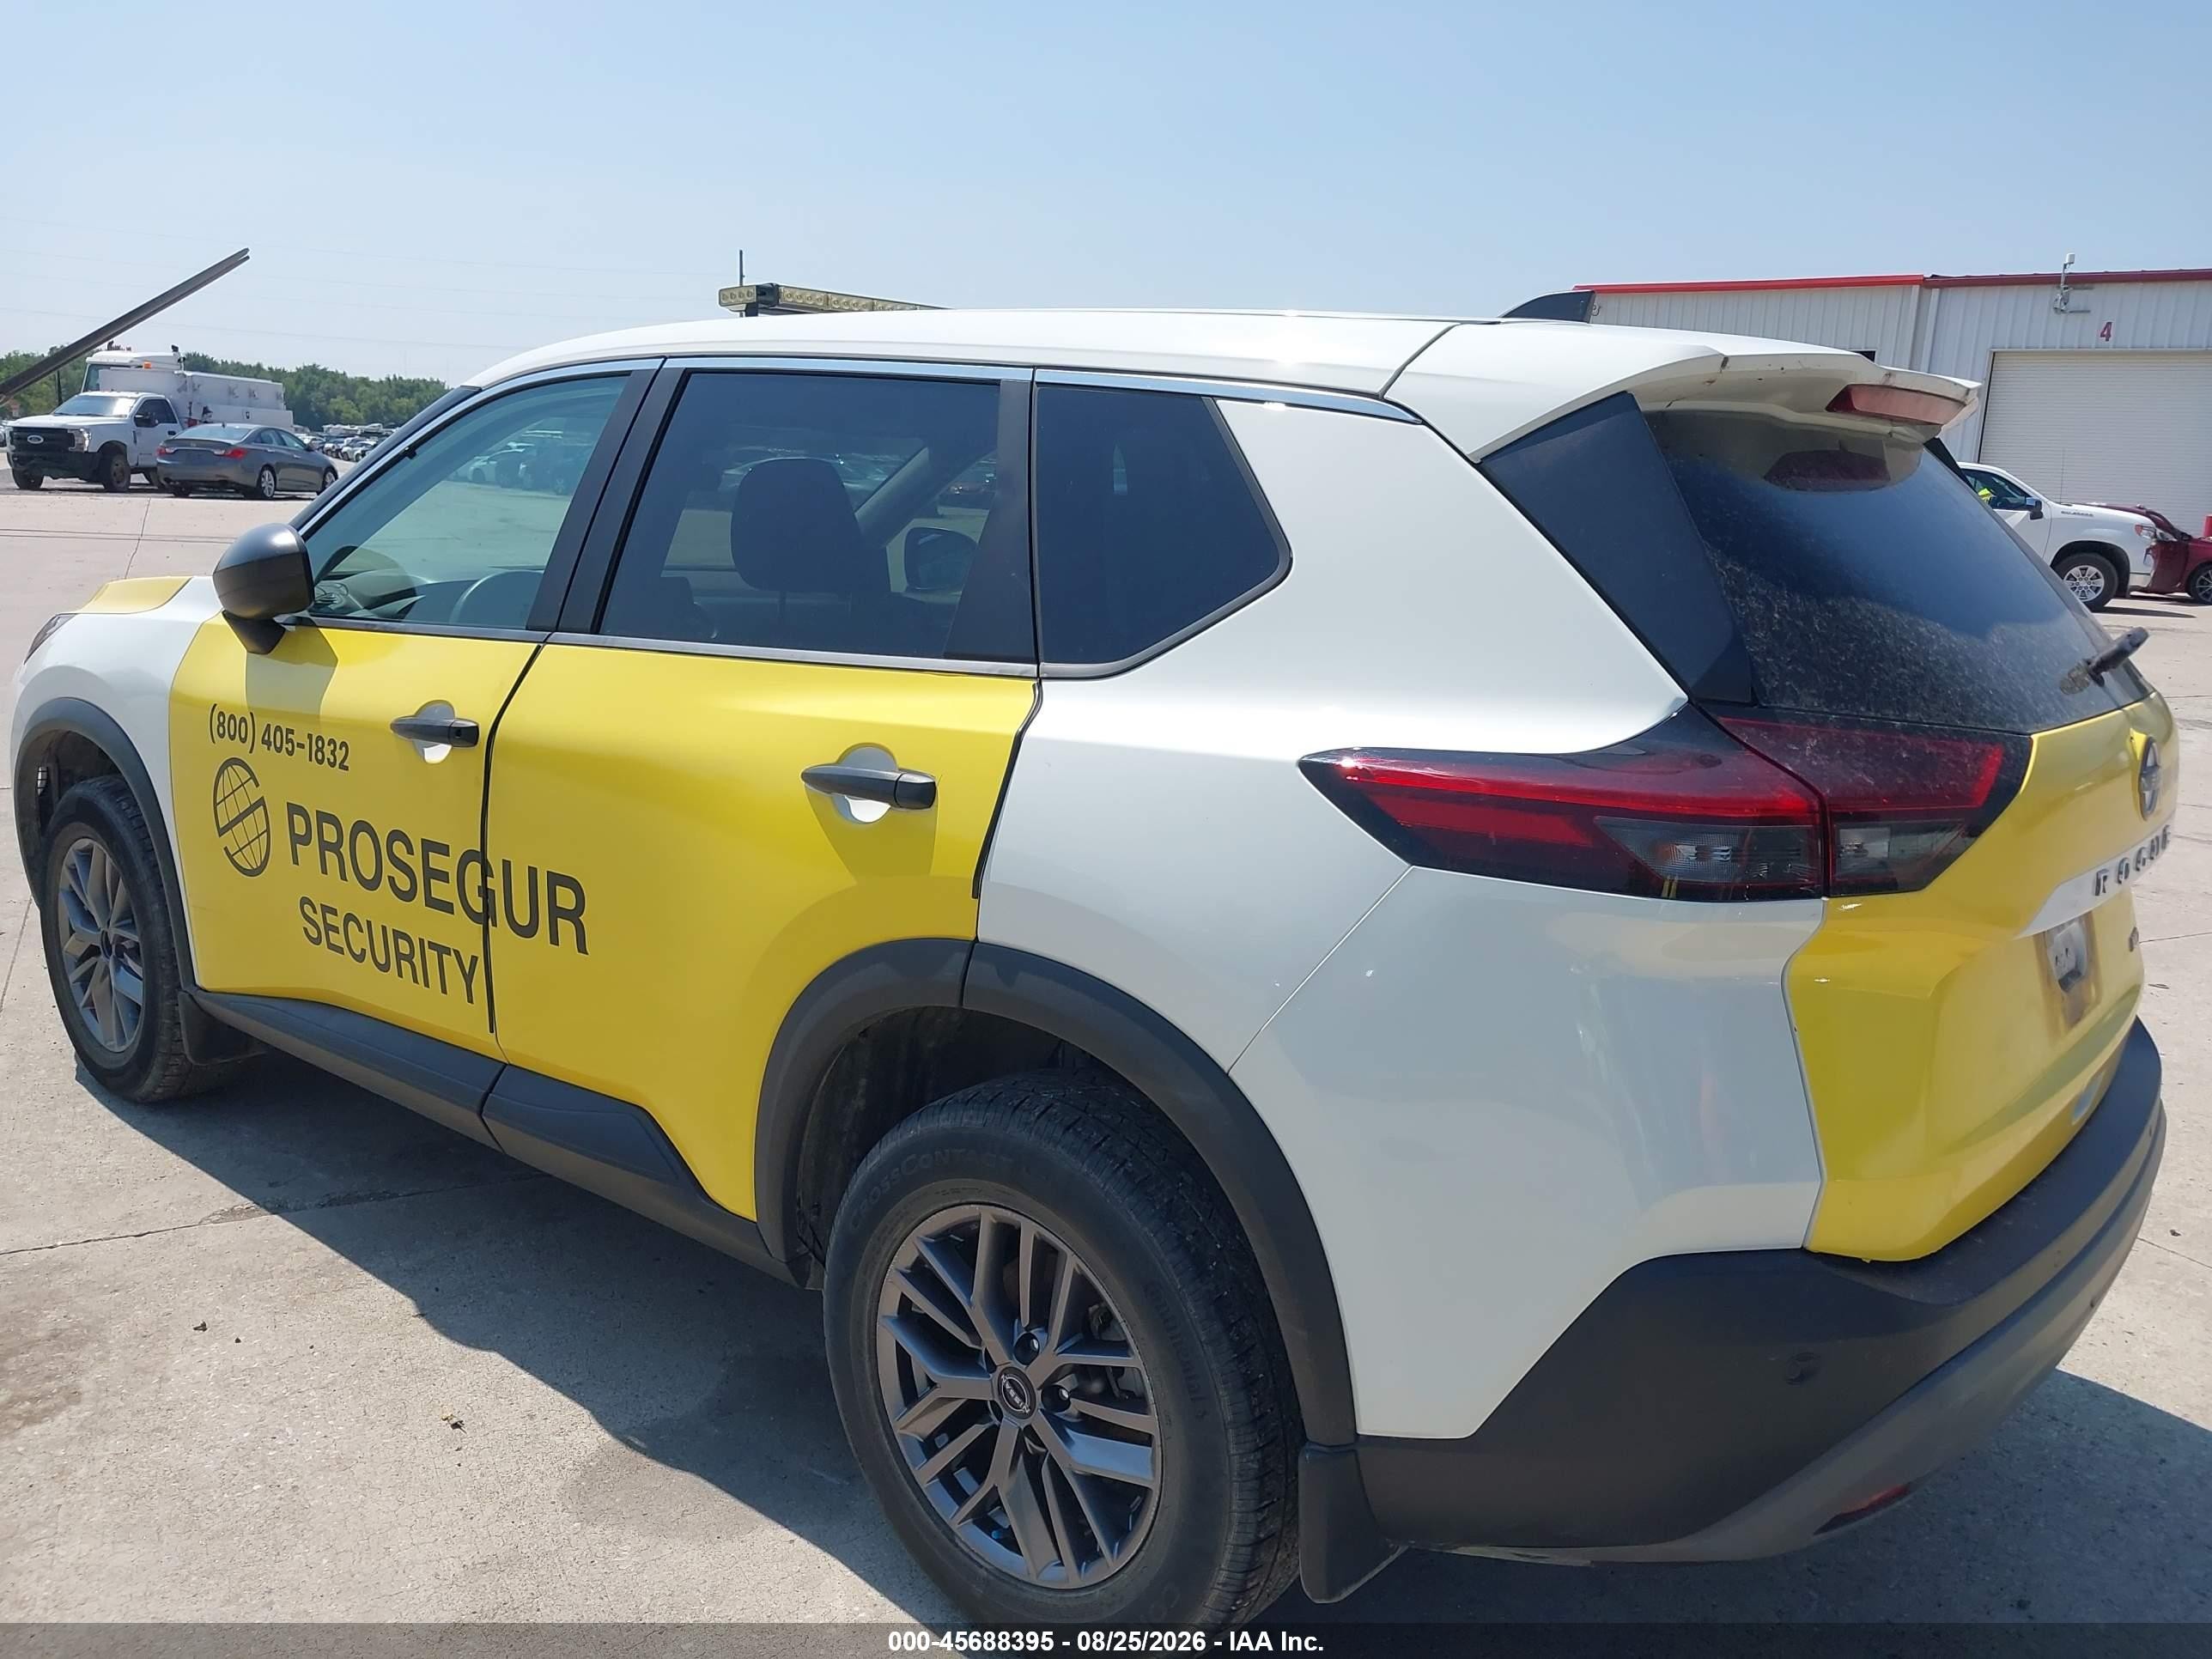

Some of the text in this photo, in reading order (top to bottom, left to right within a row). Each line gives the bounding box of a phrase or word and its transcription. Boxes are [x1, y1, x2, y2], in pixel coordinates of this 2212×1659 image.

[2100, 322, 2112, 342] 4
[209, 703, 350, 771] (800) 405-1832
[286, 801, 590, 957] PROSEGUR
[2094, 824, 2171, 896] ROGUE
[299, 895, 479, 1006] SECURITY
